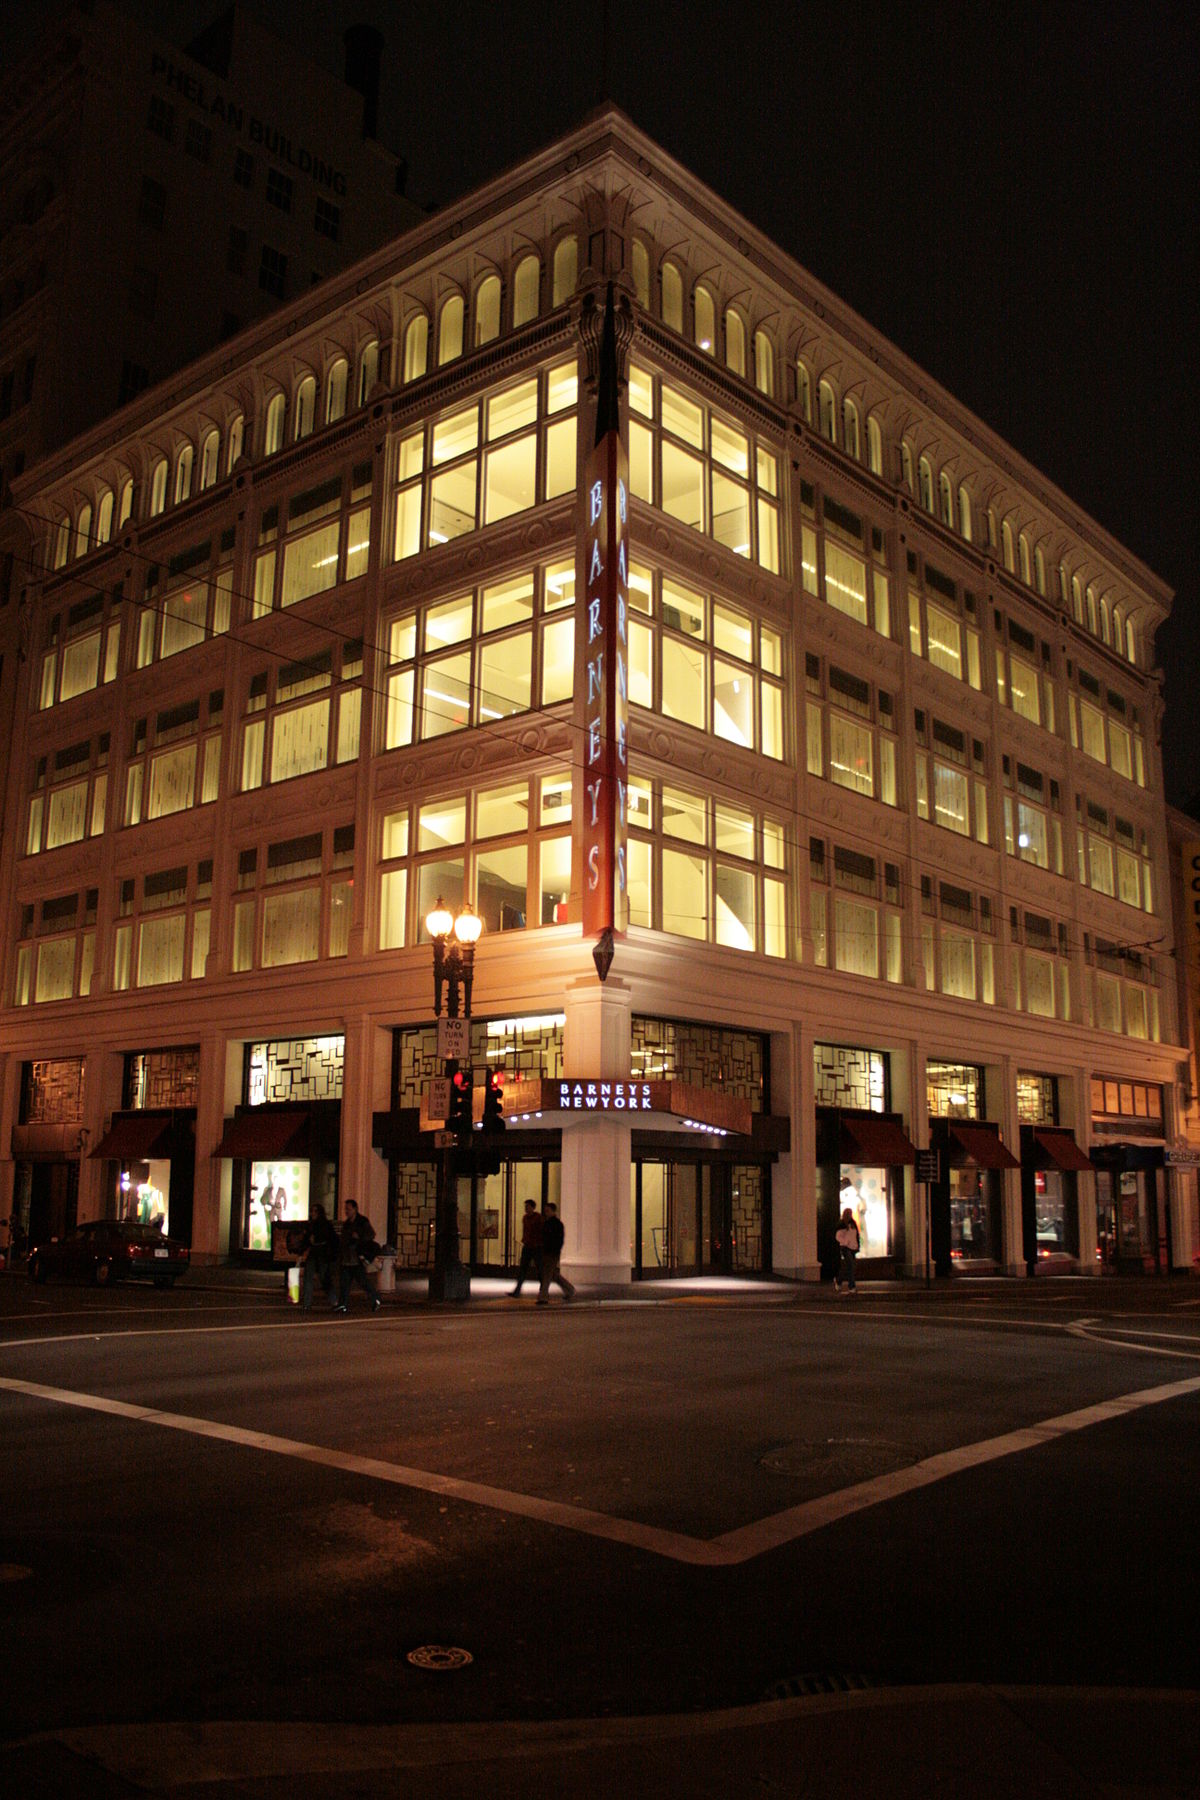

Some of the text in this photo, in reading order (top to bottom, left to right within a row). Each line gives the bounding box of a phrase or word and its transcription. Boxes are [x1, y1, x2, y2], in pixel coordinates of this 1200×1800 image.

[151, 53, 347, 196] PHELAN BUILDING
[588, 480, 604, 891] BARNEYS
[616, 478, 627, 891] BARNEYS
[446, 1021, 462, 1030] NO
[560, 1083, 651, 1096] BARNEYS
